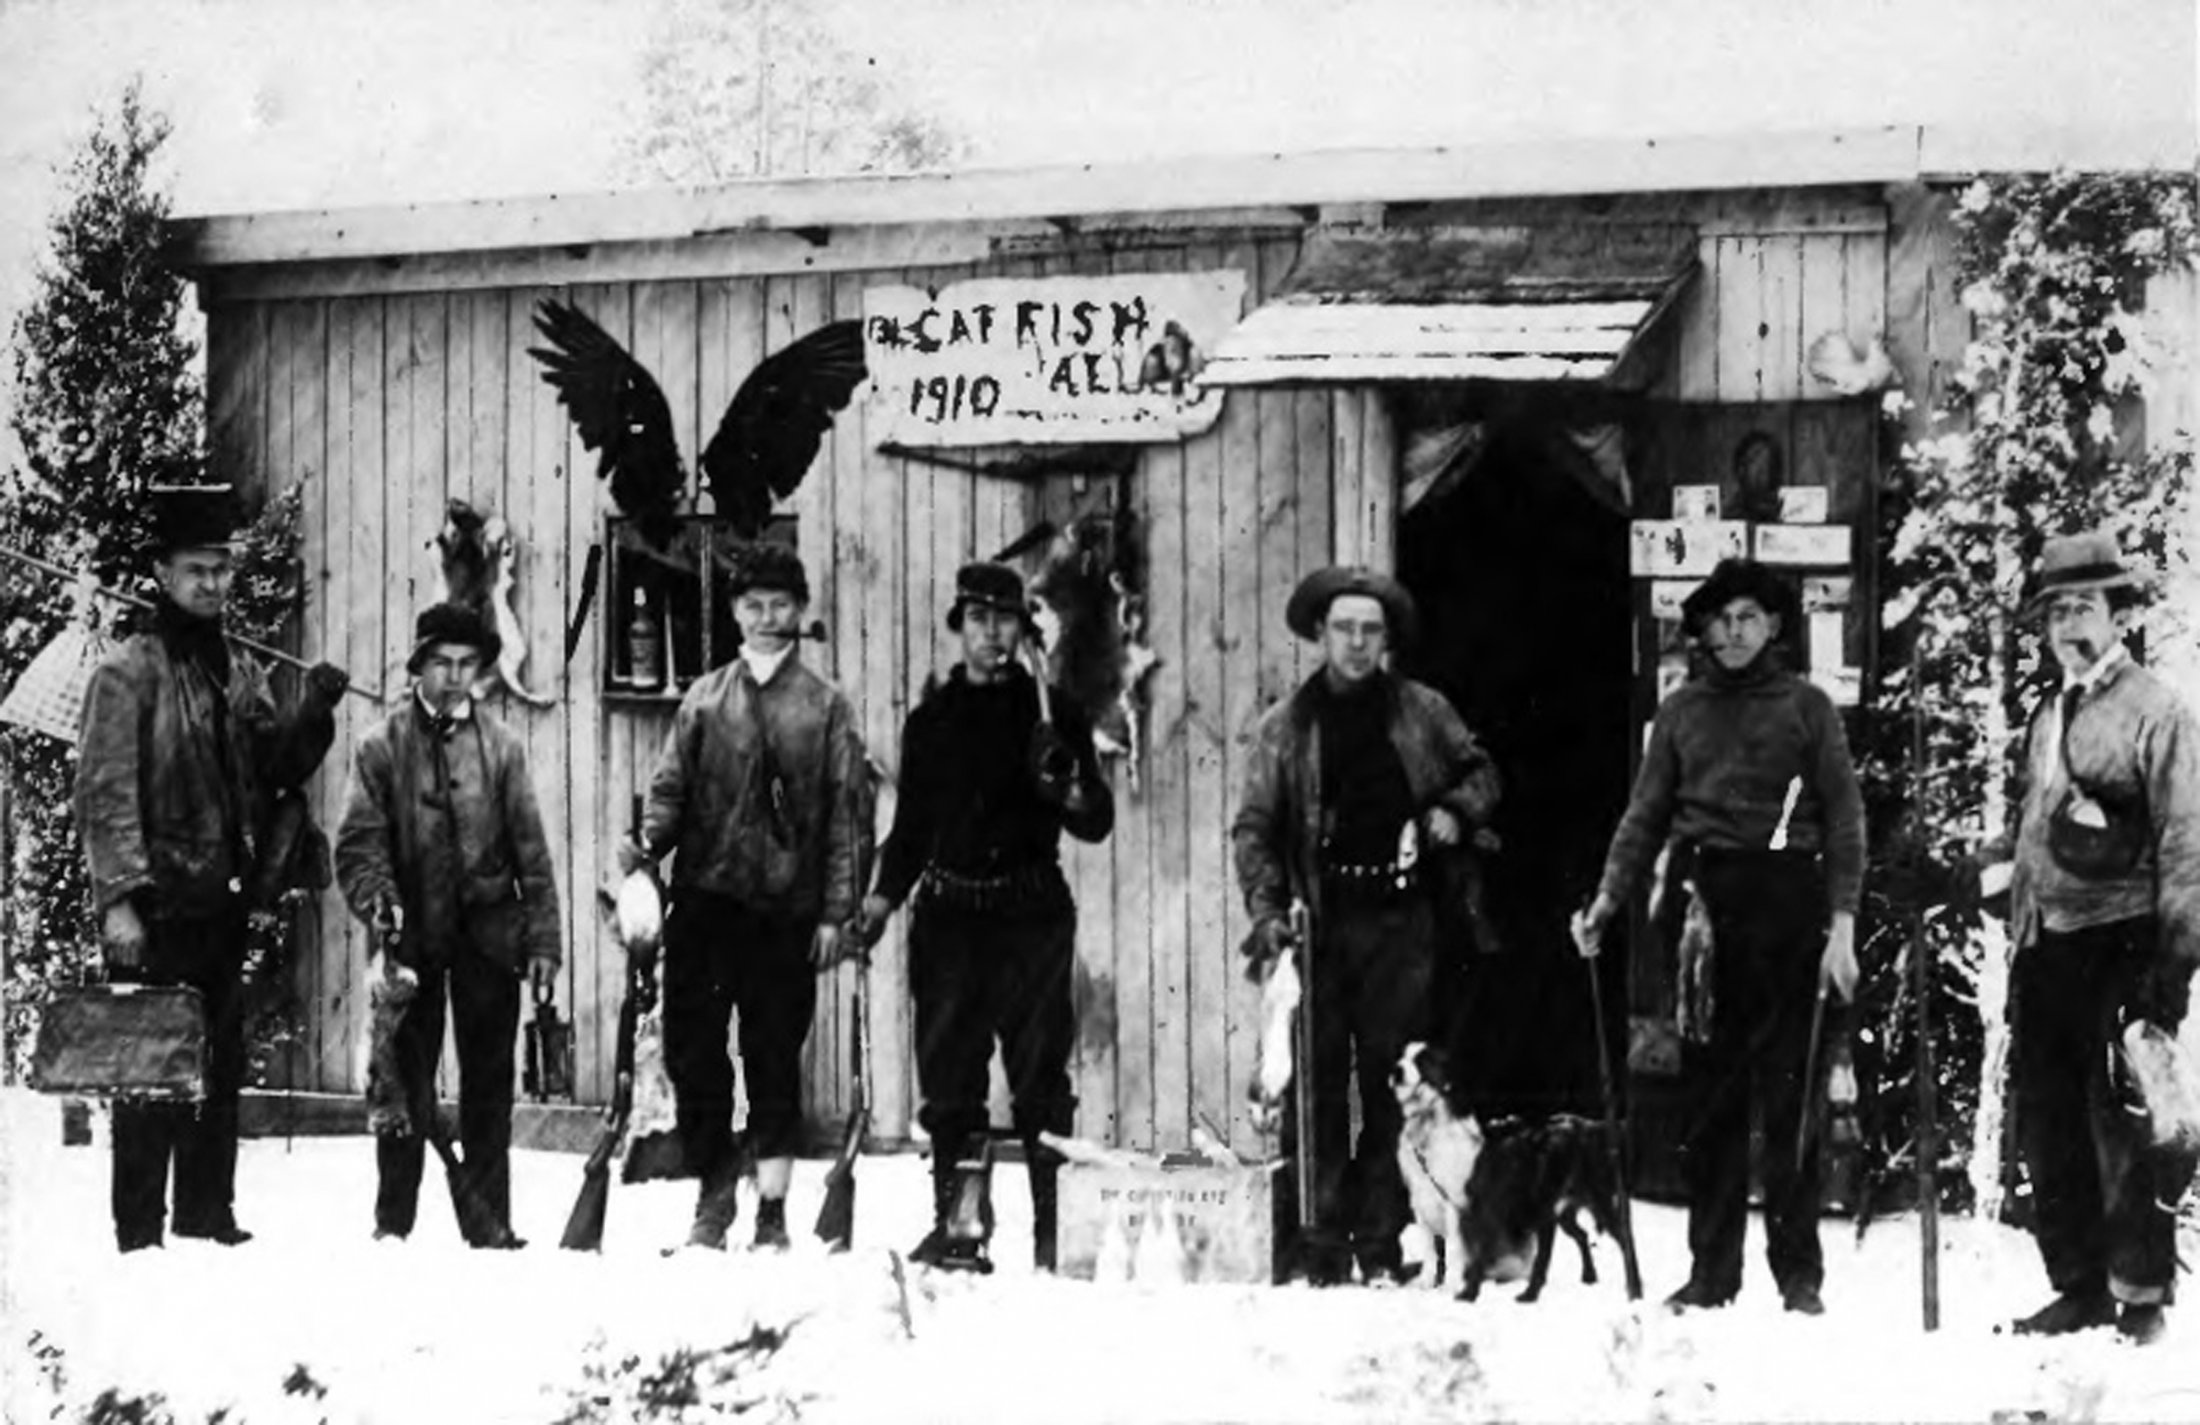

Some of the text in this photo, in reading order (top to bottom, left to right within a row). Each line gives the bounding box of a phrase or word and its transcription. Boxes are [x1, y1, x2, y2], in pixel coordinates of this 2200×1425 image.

[908, 305, 996, 352] CAT
[1016, 296, 1149, 348] FISH
[910, 373, 1000, 424] 1910
